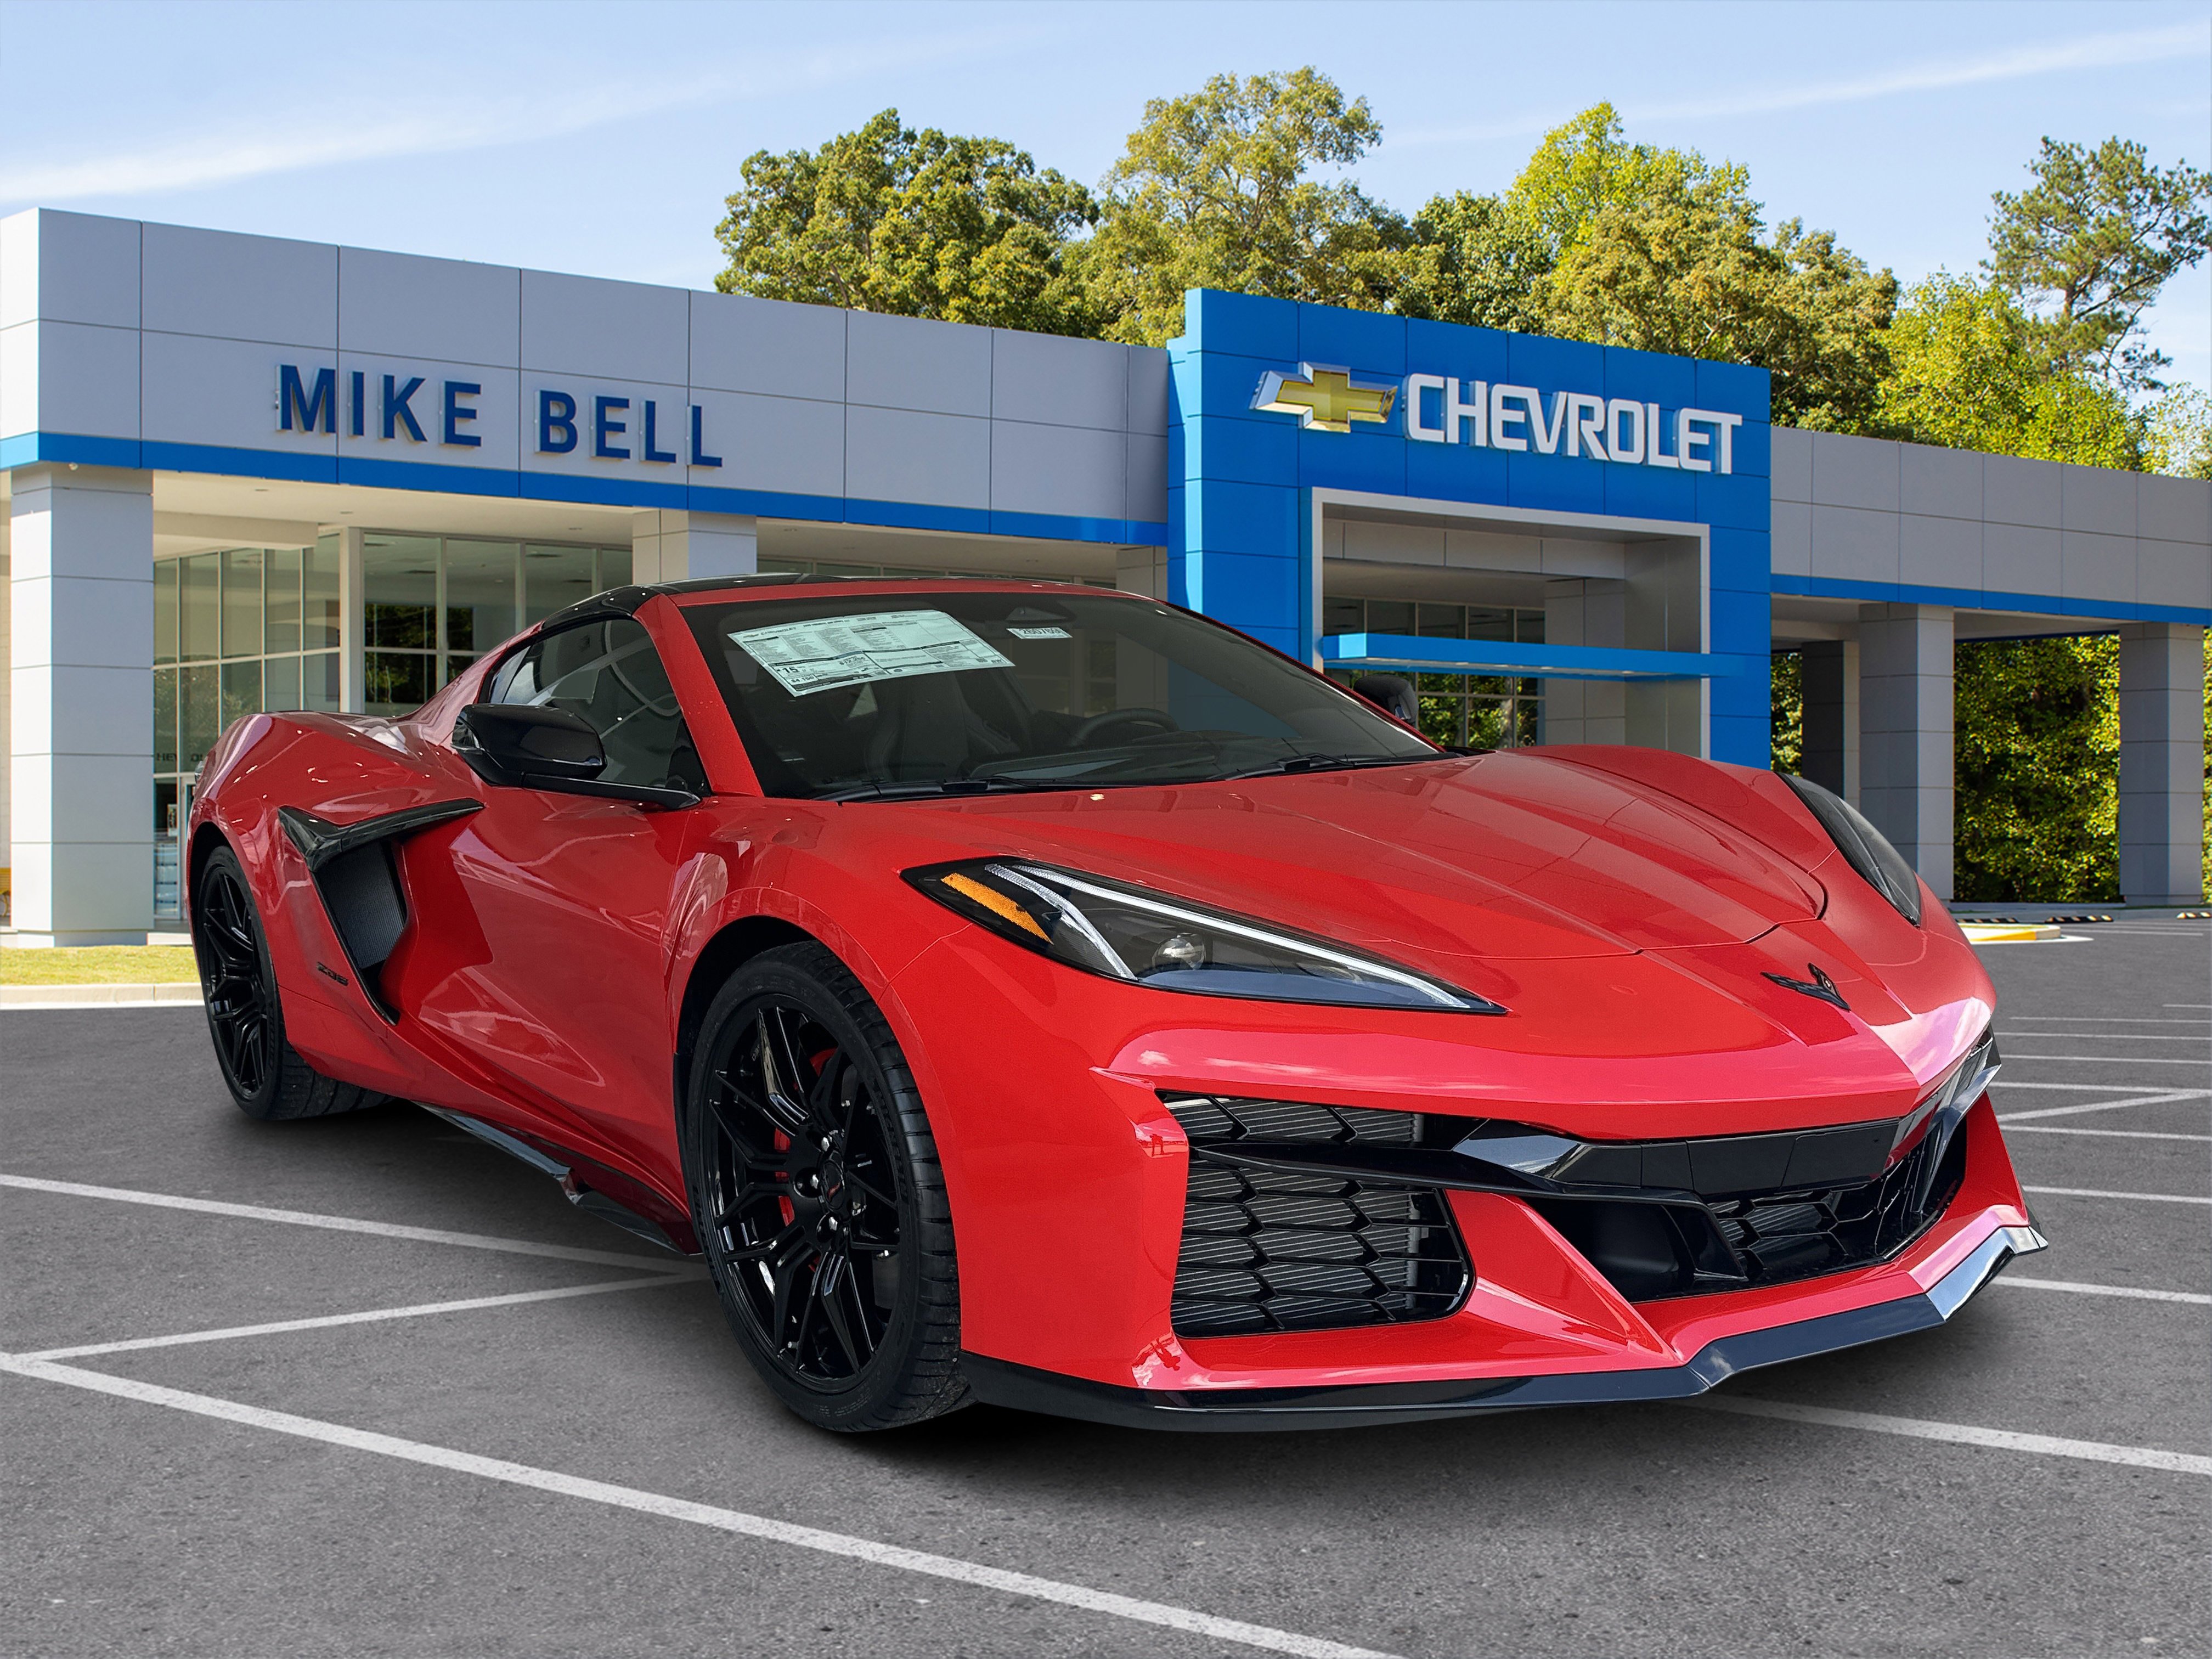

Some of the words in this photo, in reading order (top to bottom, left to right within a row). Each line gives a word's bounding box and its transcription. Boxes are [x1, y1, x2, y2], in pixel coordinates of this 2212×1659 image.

[276, 364, 482, 447] MIKE
[534, 390, 723, 468] BELL
[1402, 373, 1742, 475] CHEVROLET
